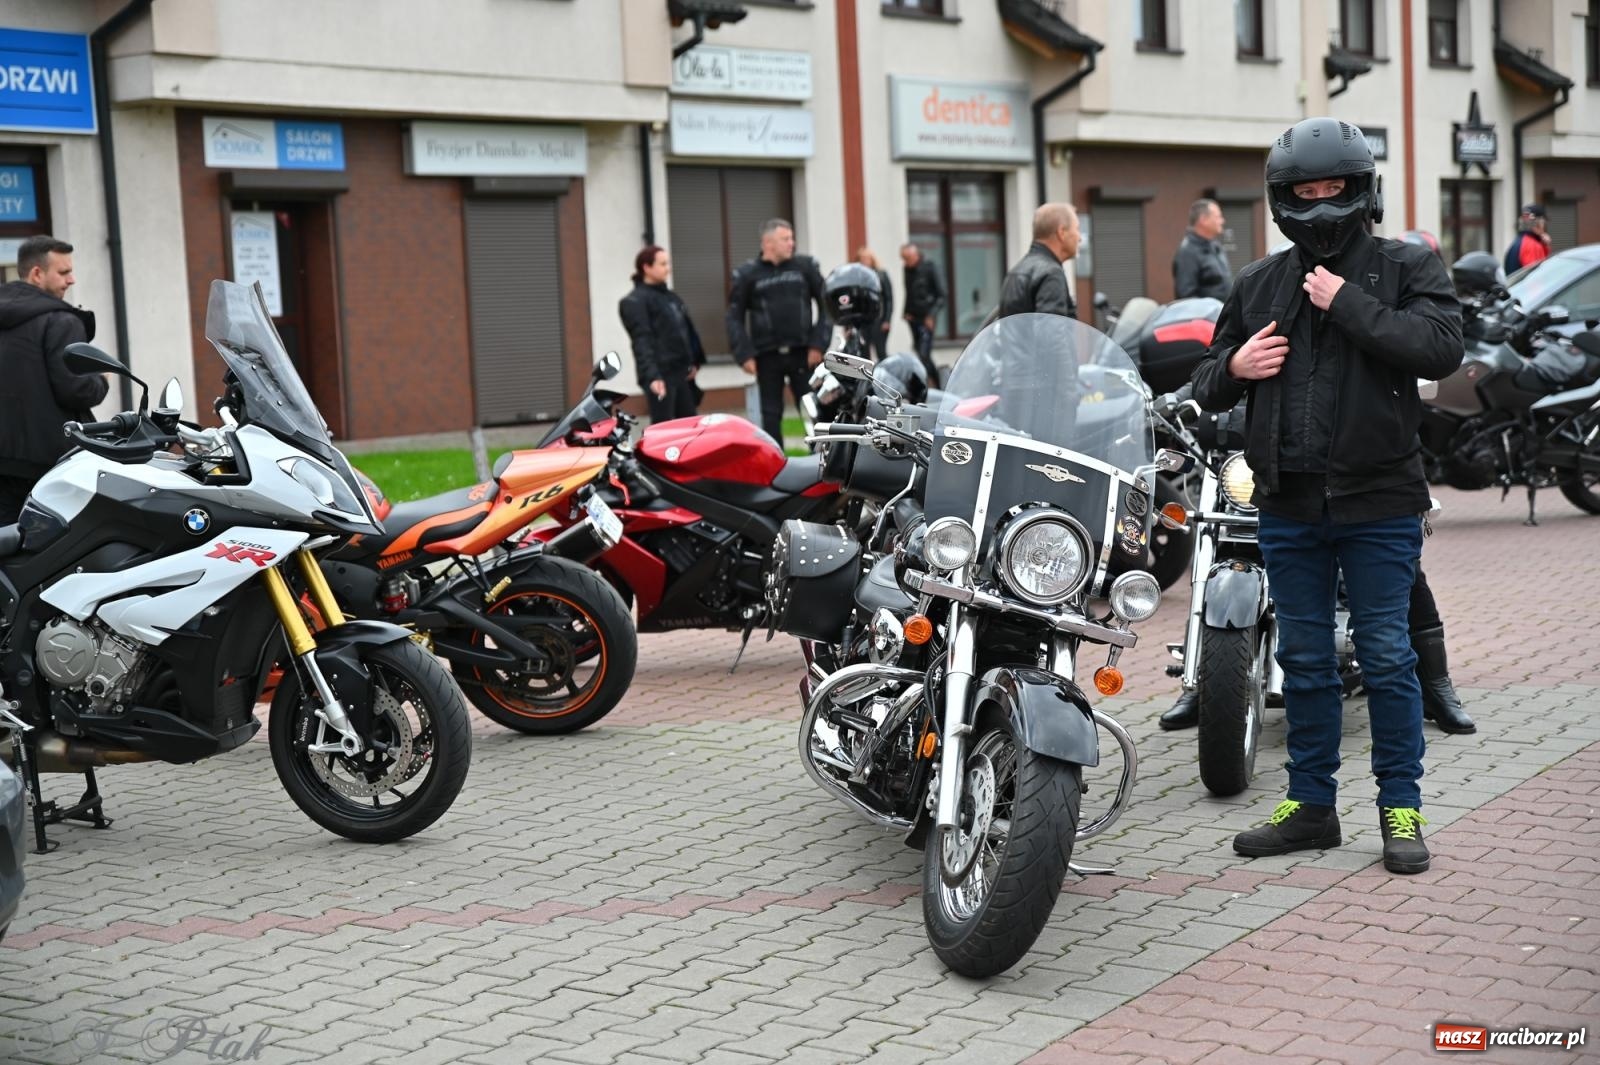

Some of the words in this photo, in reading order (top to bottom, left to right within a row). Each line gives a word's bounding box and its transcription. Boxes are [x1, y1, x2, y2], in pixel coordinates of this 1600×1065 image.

[922, 85, 1013, 127] dentica
[286, 129, 333, 145] SALON
[286, 146, 334, 162] DRZWI
[519, 484, 564, 510] R6
[204, 542, 278, 568] XR
[376, 550, 413, 570] YAMAHA
[658, 616, 712, 628] YAMAHA
